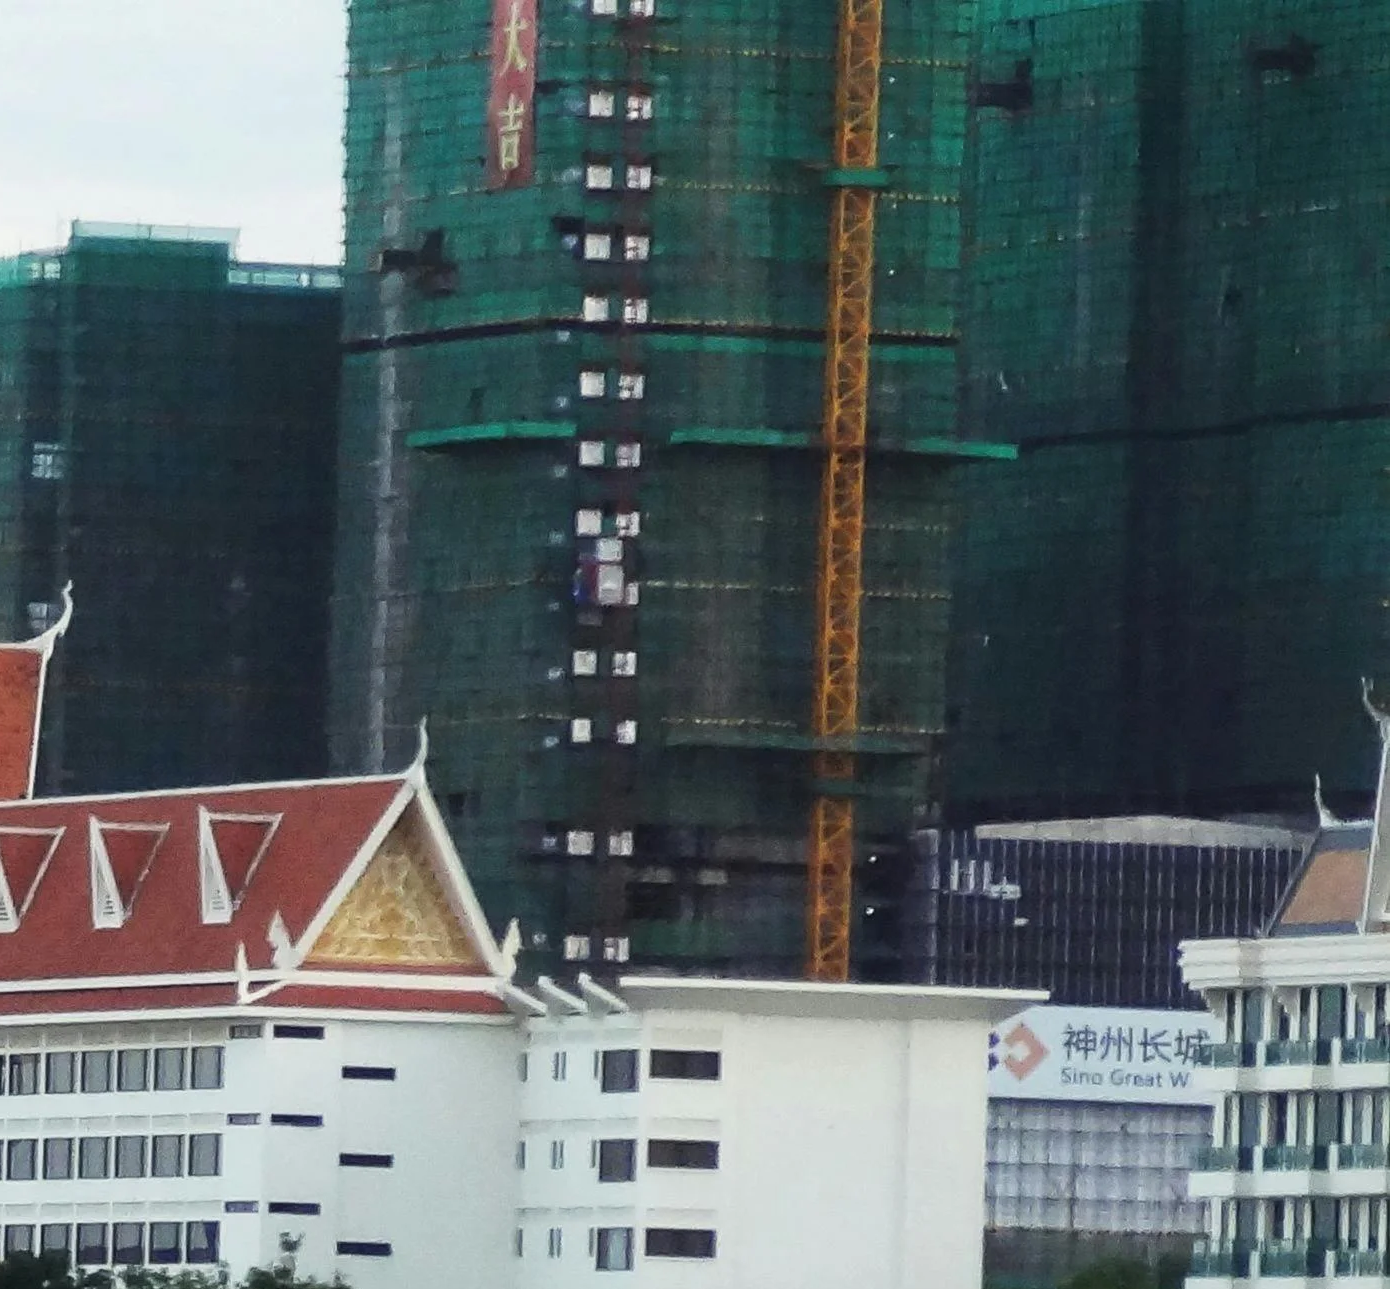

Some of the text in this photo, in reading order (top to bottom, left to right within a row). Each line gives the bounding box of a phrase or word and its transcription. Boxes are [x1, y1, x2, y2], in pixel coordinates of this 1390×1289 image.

[498, 1, 530, 171] 大吉
[1061, 1067, 1103, 1086] Sino
[1110, 1068, 1163, 1087] Great
